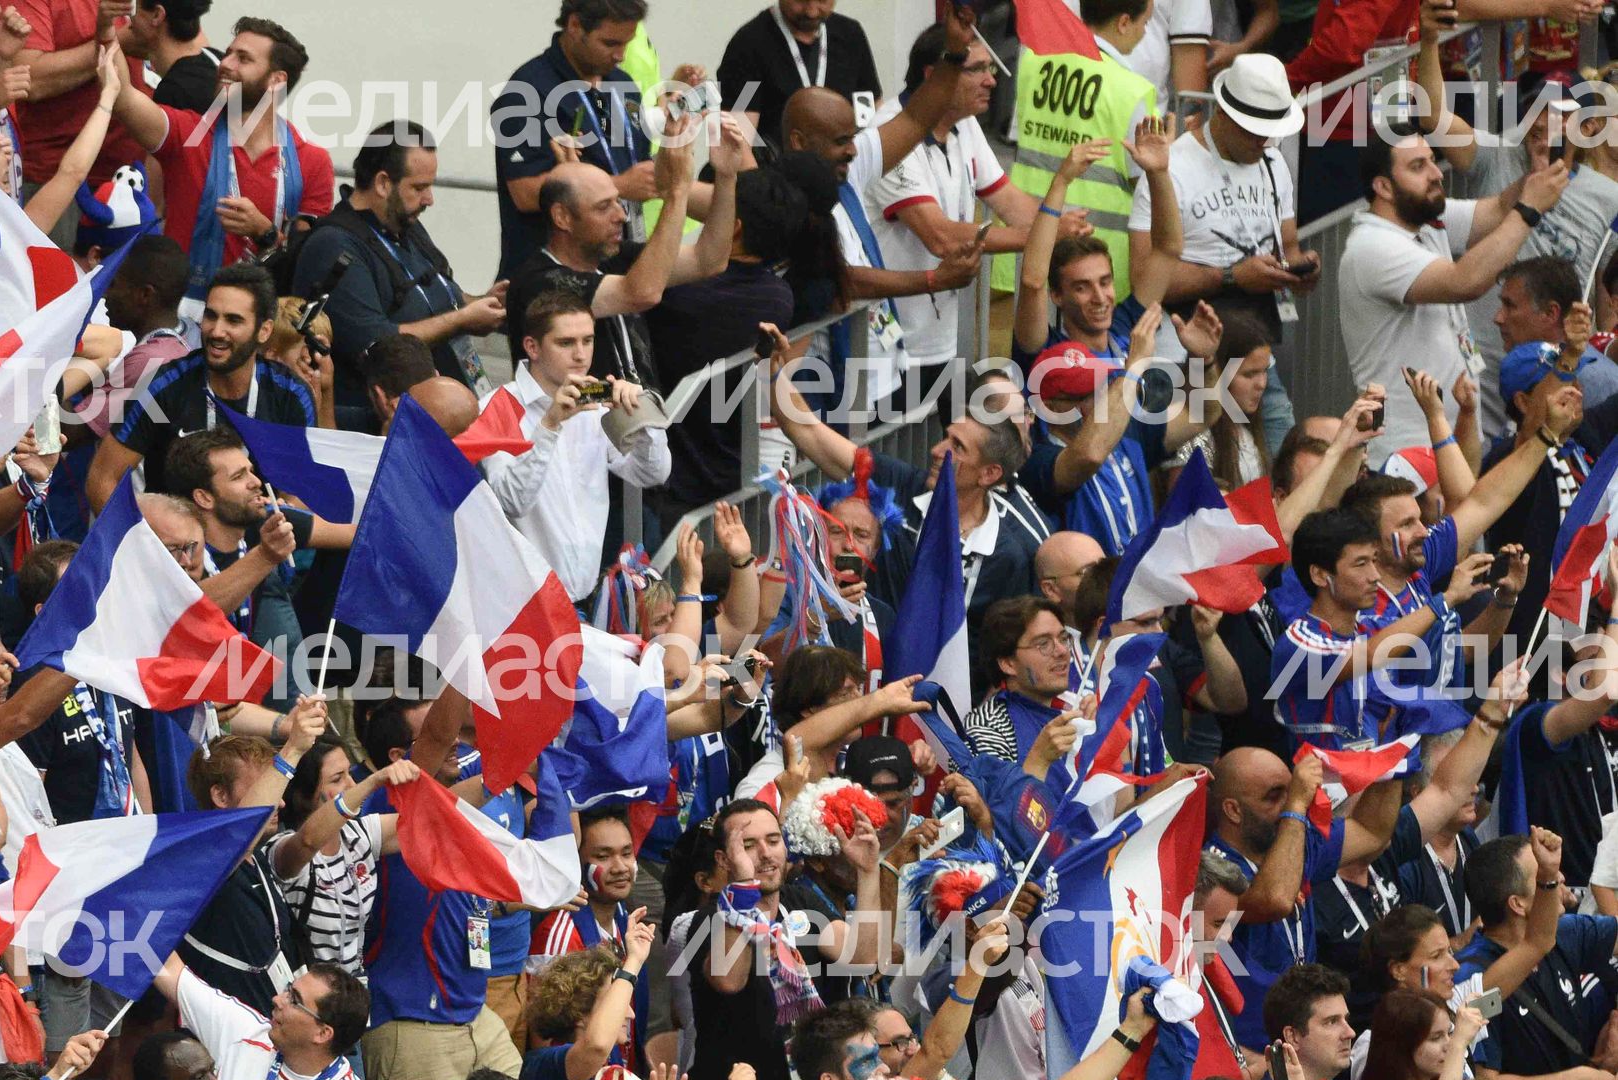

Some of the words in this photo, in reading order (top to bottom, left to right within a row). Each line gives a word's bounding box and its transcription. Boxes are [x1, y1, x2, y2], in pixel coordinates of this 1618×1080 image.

[1033, 61, 1102, 120] 3000
[1024, 120, 1093, 146] STEWARD
[1191, 185, 1272, 219] CUBANI
